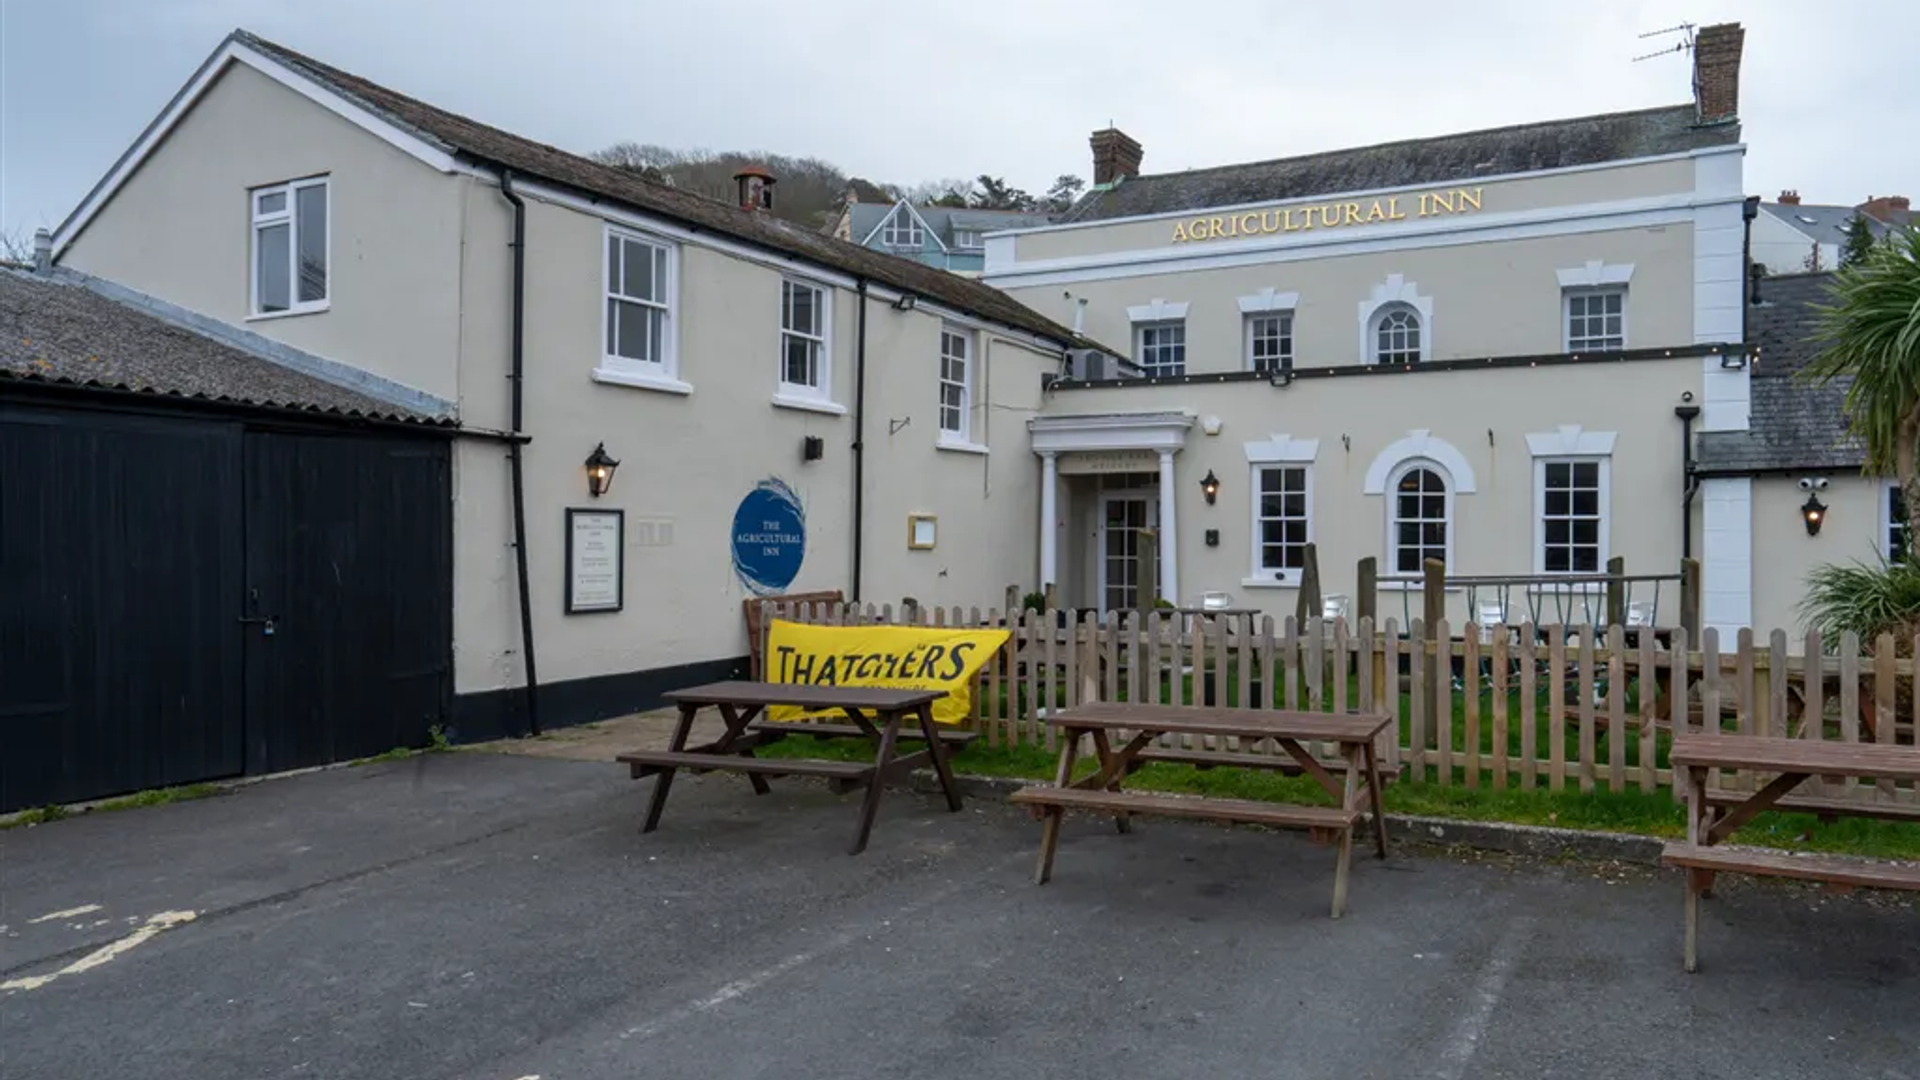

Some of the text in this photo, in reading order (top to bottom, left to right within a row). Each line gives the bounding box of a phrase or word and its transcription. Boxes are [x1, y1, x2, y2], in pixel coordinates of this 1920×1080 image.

[1172, 187, 1484, 243] AGRICULTURAL INN
[763, 520, 780, 530] THE
[737, 533, 801, 543] AGRICULTURAL
[763, 546, 780, 556] INN
[777, 642, 976, 686] THATCHERS
